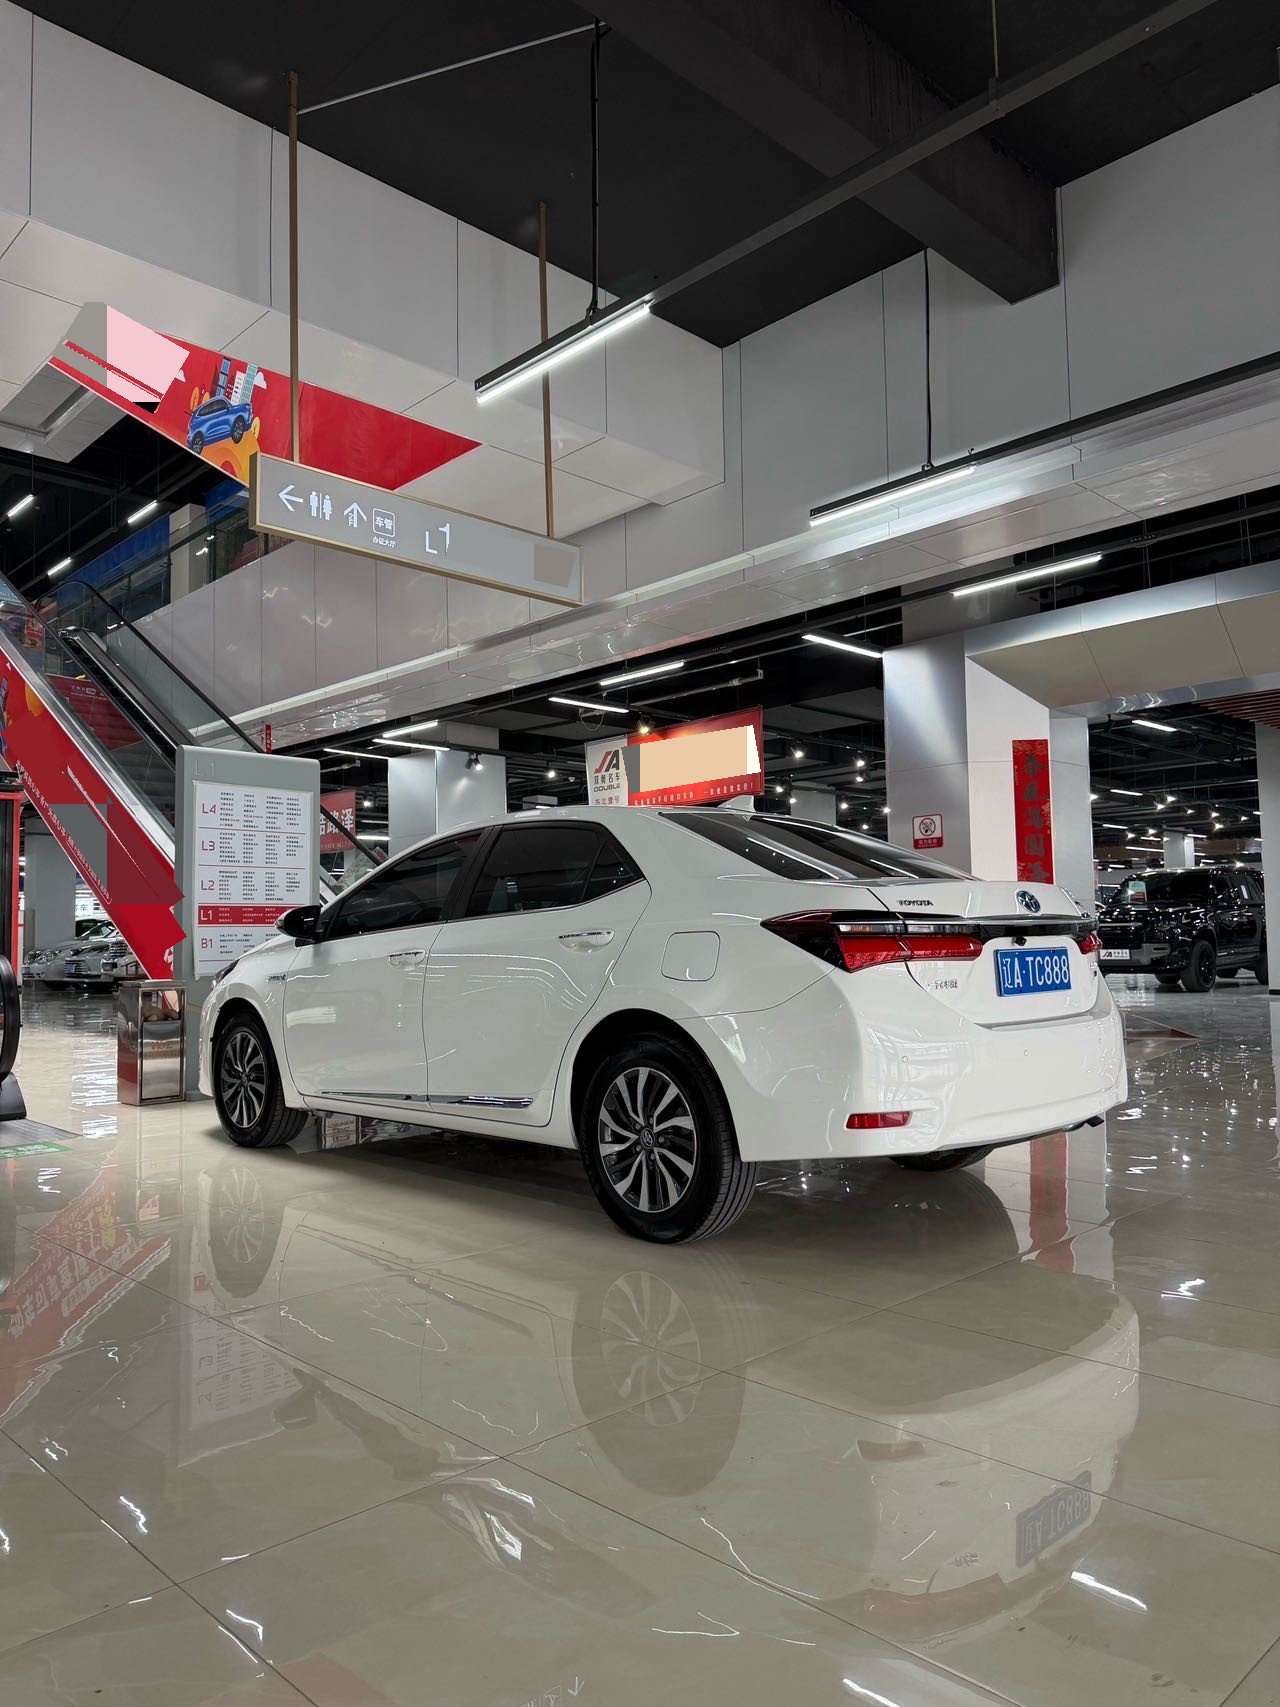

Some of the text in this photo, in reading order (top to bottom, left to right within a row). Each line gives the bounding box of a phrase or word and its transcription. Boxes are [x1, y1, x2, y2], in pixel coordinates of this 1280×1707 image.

[375, 516, 393, 530] 车管
[425, 523, 450, 555] L1
[594, 783, 621, 793] DOUBLE
[202, 803, 217, 814] L4
[201, 840, 216, 851] L3
[201, 880, 215, 891] L2
[896, 899, 934, 907] TOYOTA
[200, 909, 213, 921] L1
[201, 938, 213, 949] B1
[1002, 955, 1069, 989] 辽A·TC888
